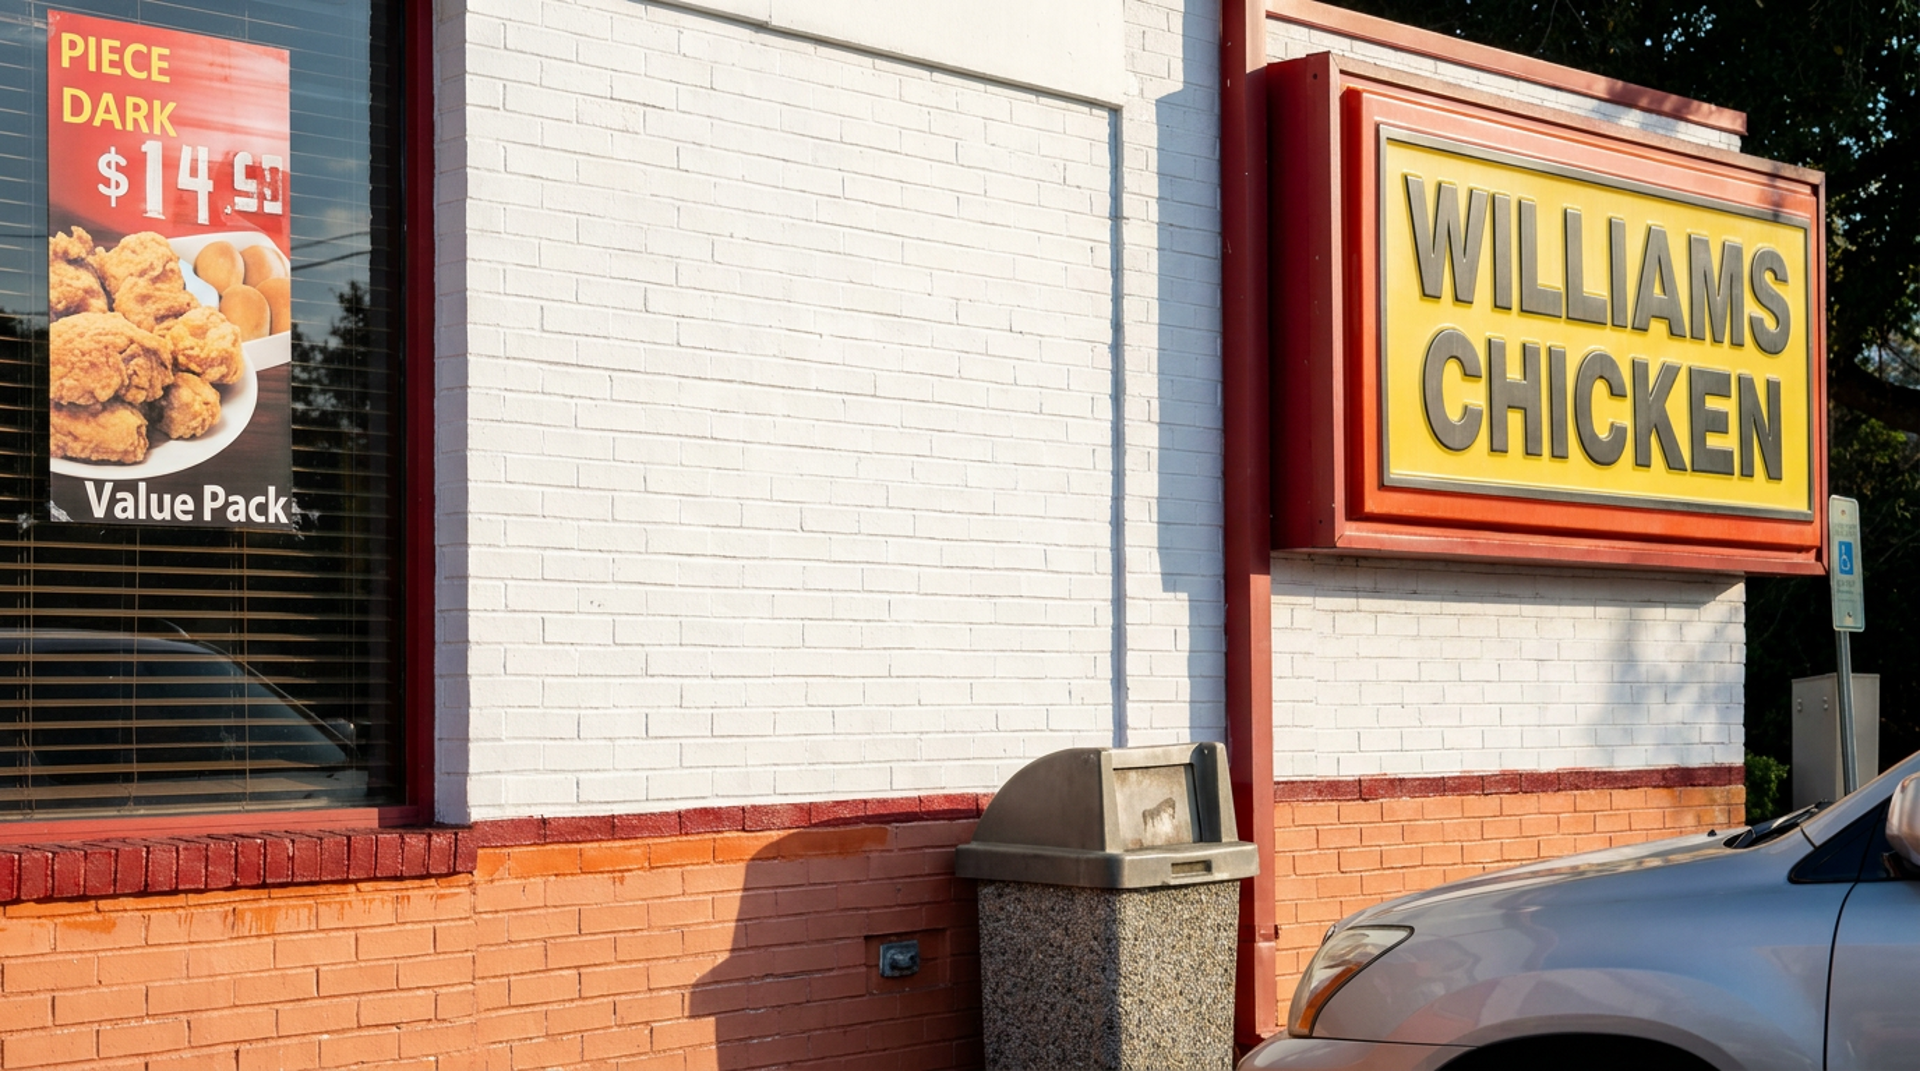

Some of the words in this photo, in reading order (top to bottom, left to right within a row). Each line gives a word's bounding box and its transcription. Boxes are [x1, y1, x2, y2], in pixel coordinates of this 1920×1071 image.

[61, 32, 170, 83] PIECE
[63, 87, 177, 137] DARK
[1404, 172, 1791, 356] WILLIAMS
[1422, 327, 1783, 481] CHICKEN
[84, 481, 194, 521] Value
[203, 484, 289, 524] Pack
